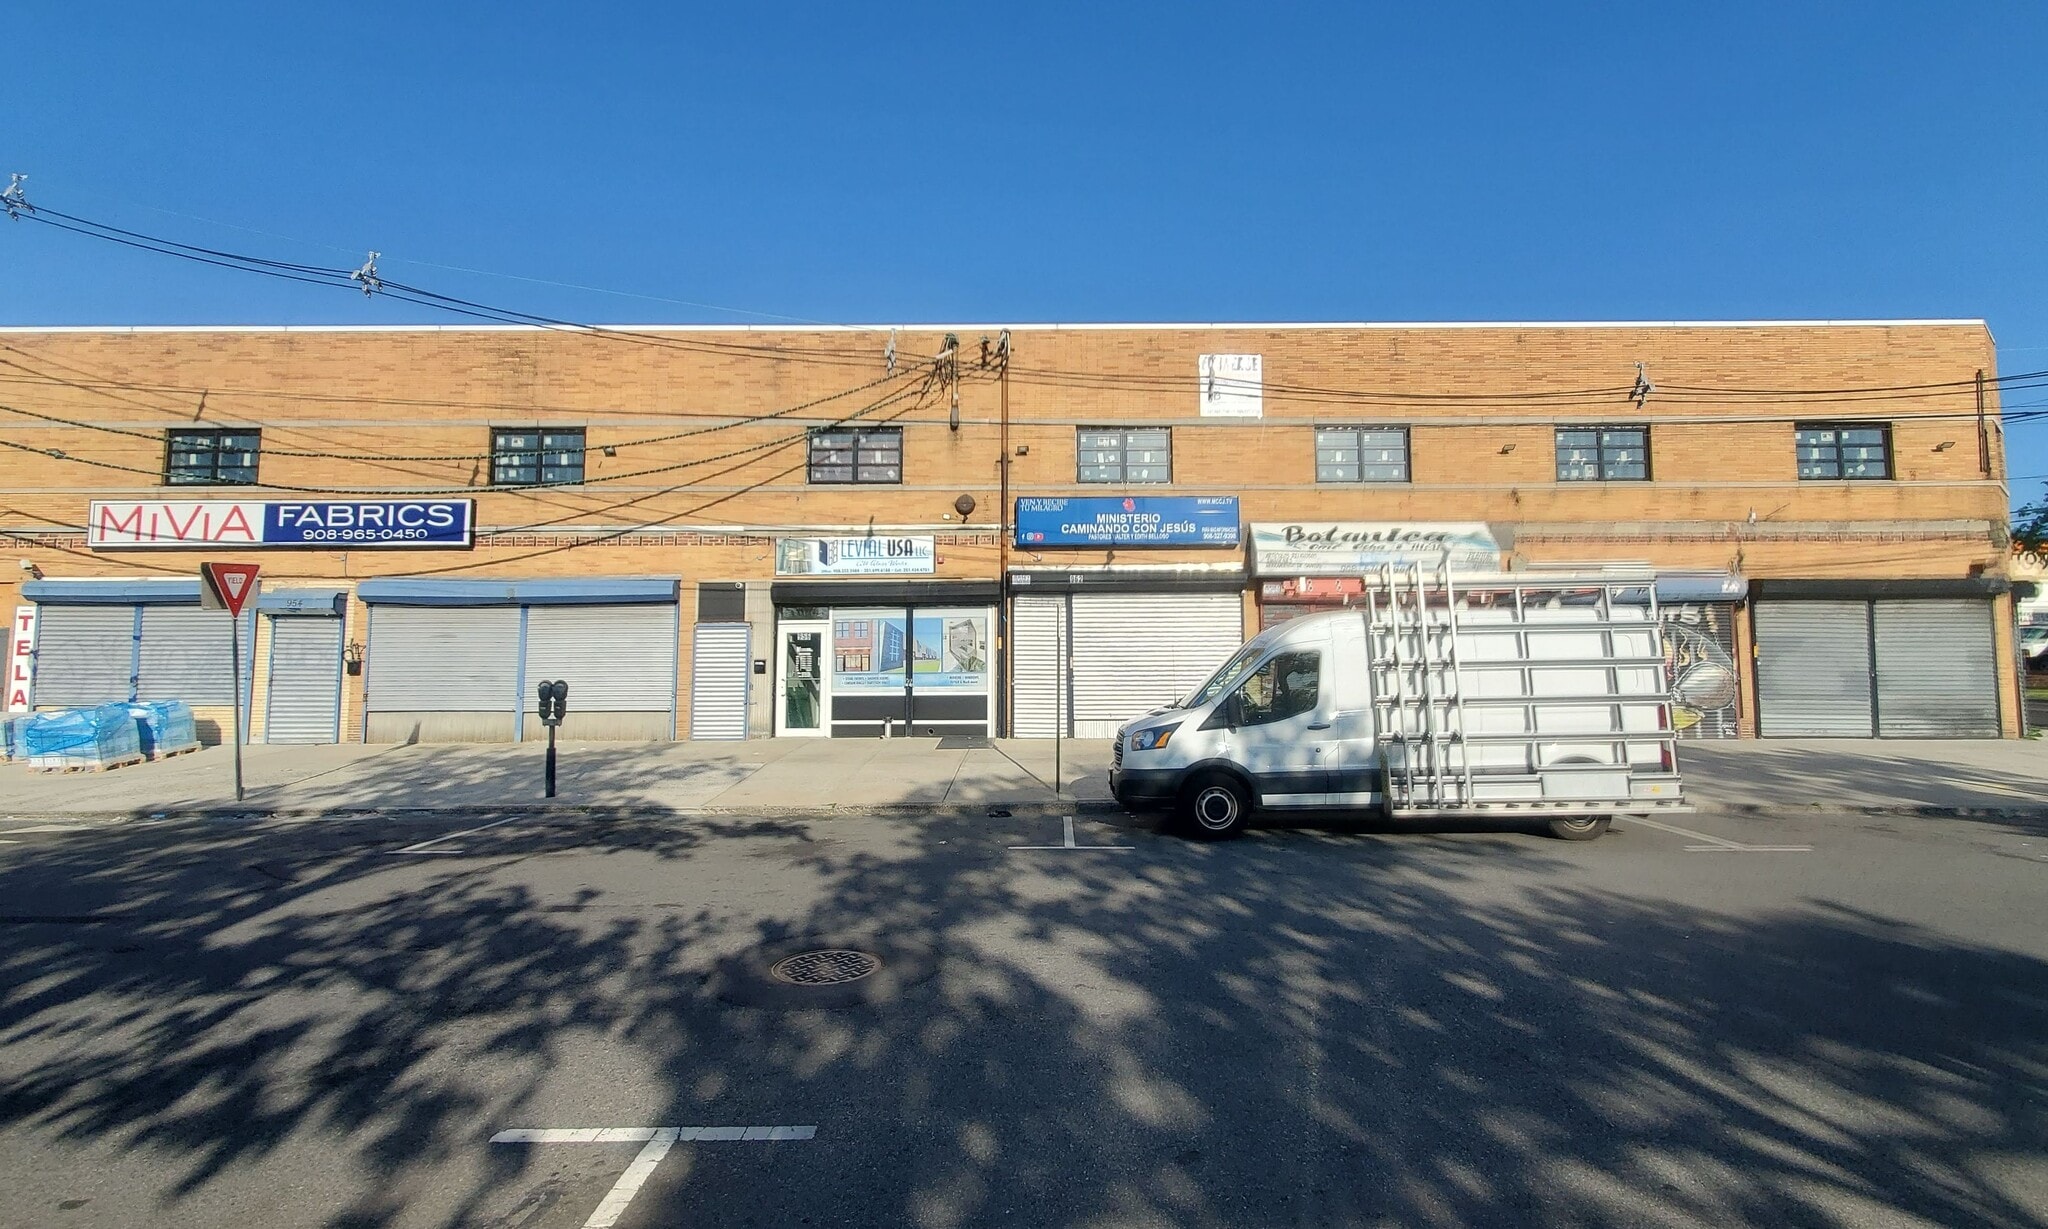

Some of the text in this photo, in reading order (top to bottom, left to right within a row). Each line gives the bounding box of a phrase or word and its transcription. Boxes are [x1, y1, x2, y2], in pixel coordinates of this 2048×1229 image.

[278, 504, 454, 527] FABRICS
[1096, 513, 1161, 524] MINISTERIO
[302, 528, 429, 540] 908-965-0450
[1061, 520, 1197, 534] CAMINANDO CON JESÚS
[1281, 525, 1450, 543] Botanica
[840, 539, 884, 557] LEVIAL
[887, 538, 914, 557] USA
[227, 576, 244, 585] YIELD
[10, 614, 34, 706] TELA
